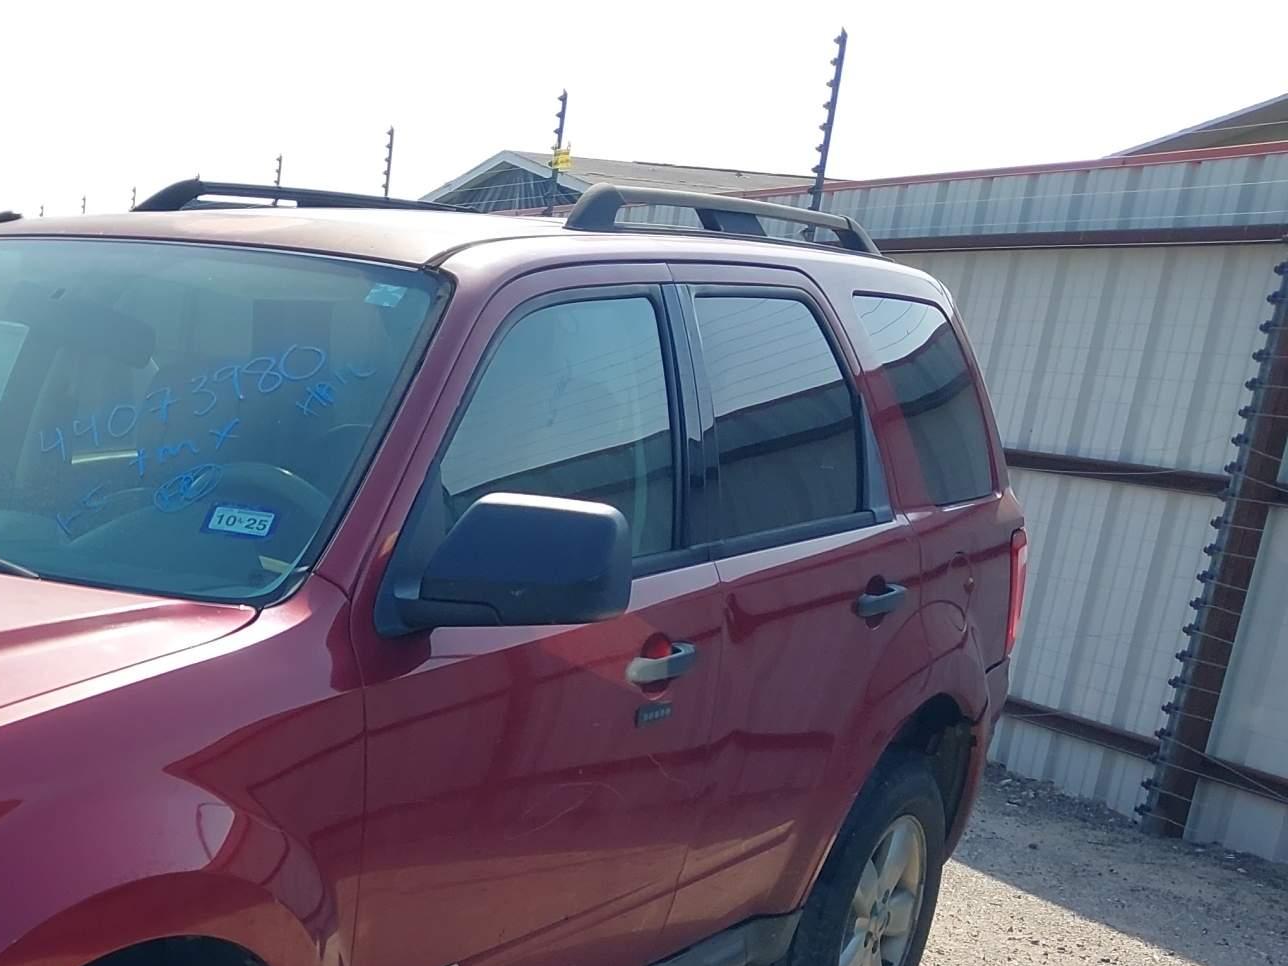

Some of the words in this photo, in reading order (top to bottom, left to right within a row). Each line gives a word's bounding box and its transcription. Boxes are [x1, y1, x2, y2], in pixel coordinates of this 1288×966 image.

[40, 344, 326, 465] 44073980
[217, 513, 237, 527] 10
[244, 517, 269, 531] 25
